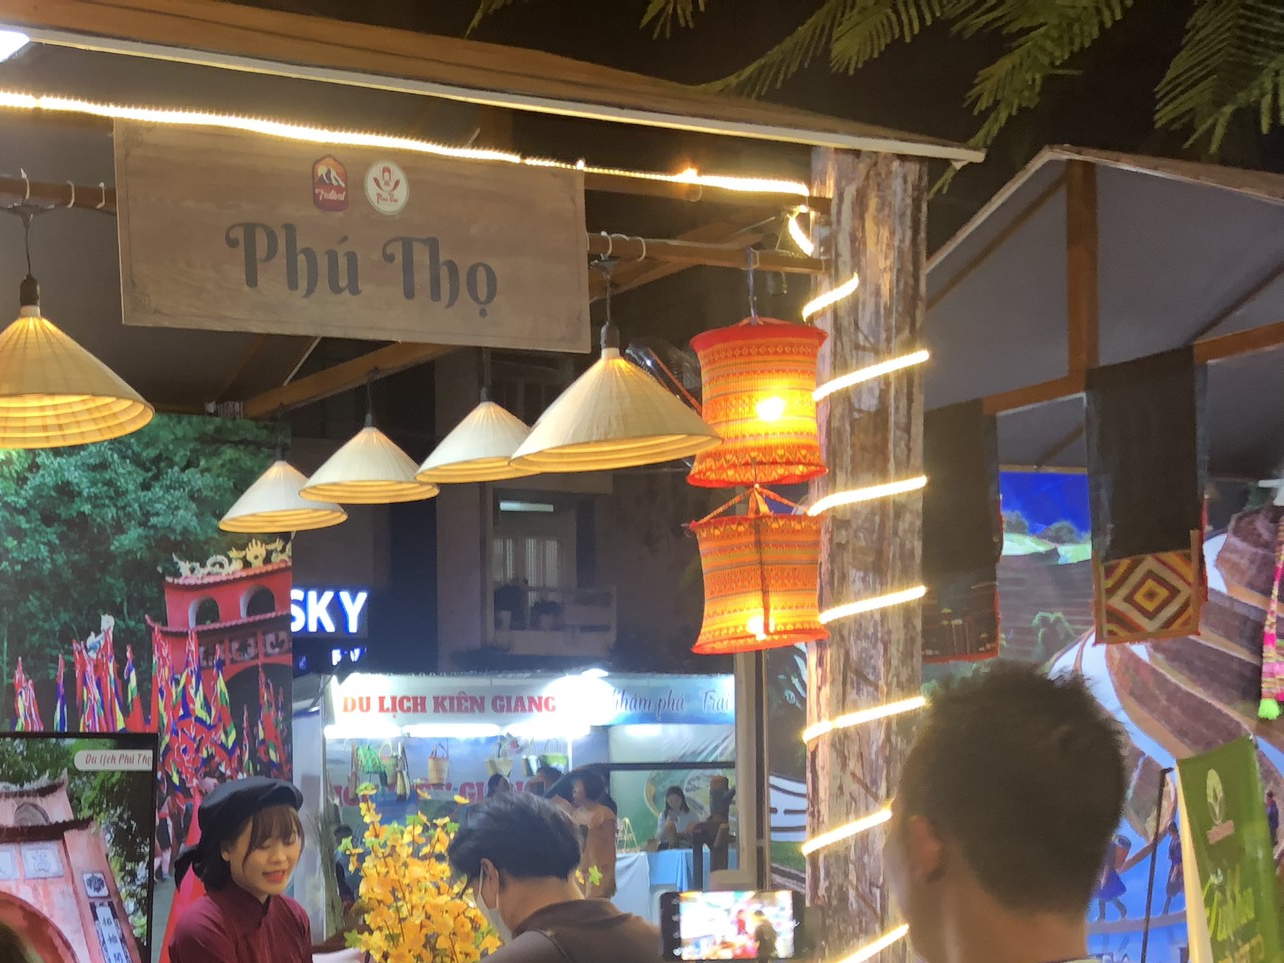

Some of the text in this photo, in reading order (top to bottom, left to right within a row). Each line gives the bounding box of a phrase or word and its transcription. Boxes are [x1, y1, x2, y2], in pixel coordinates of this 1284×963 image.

[224, 221, 498, 318] Phú Thọ
[290, 589, 368, 634] SKY
[342, 690, 558, 719] DU LỊCH KIÊN GIANG
